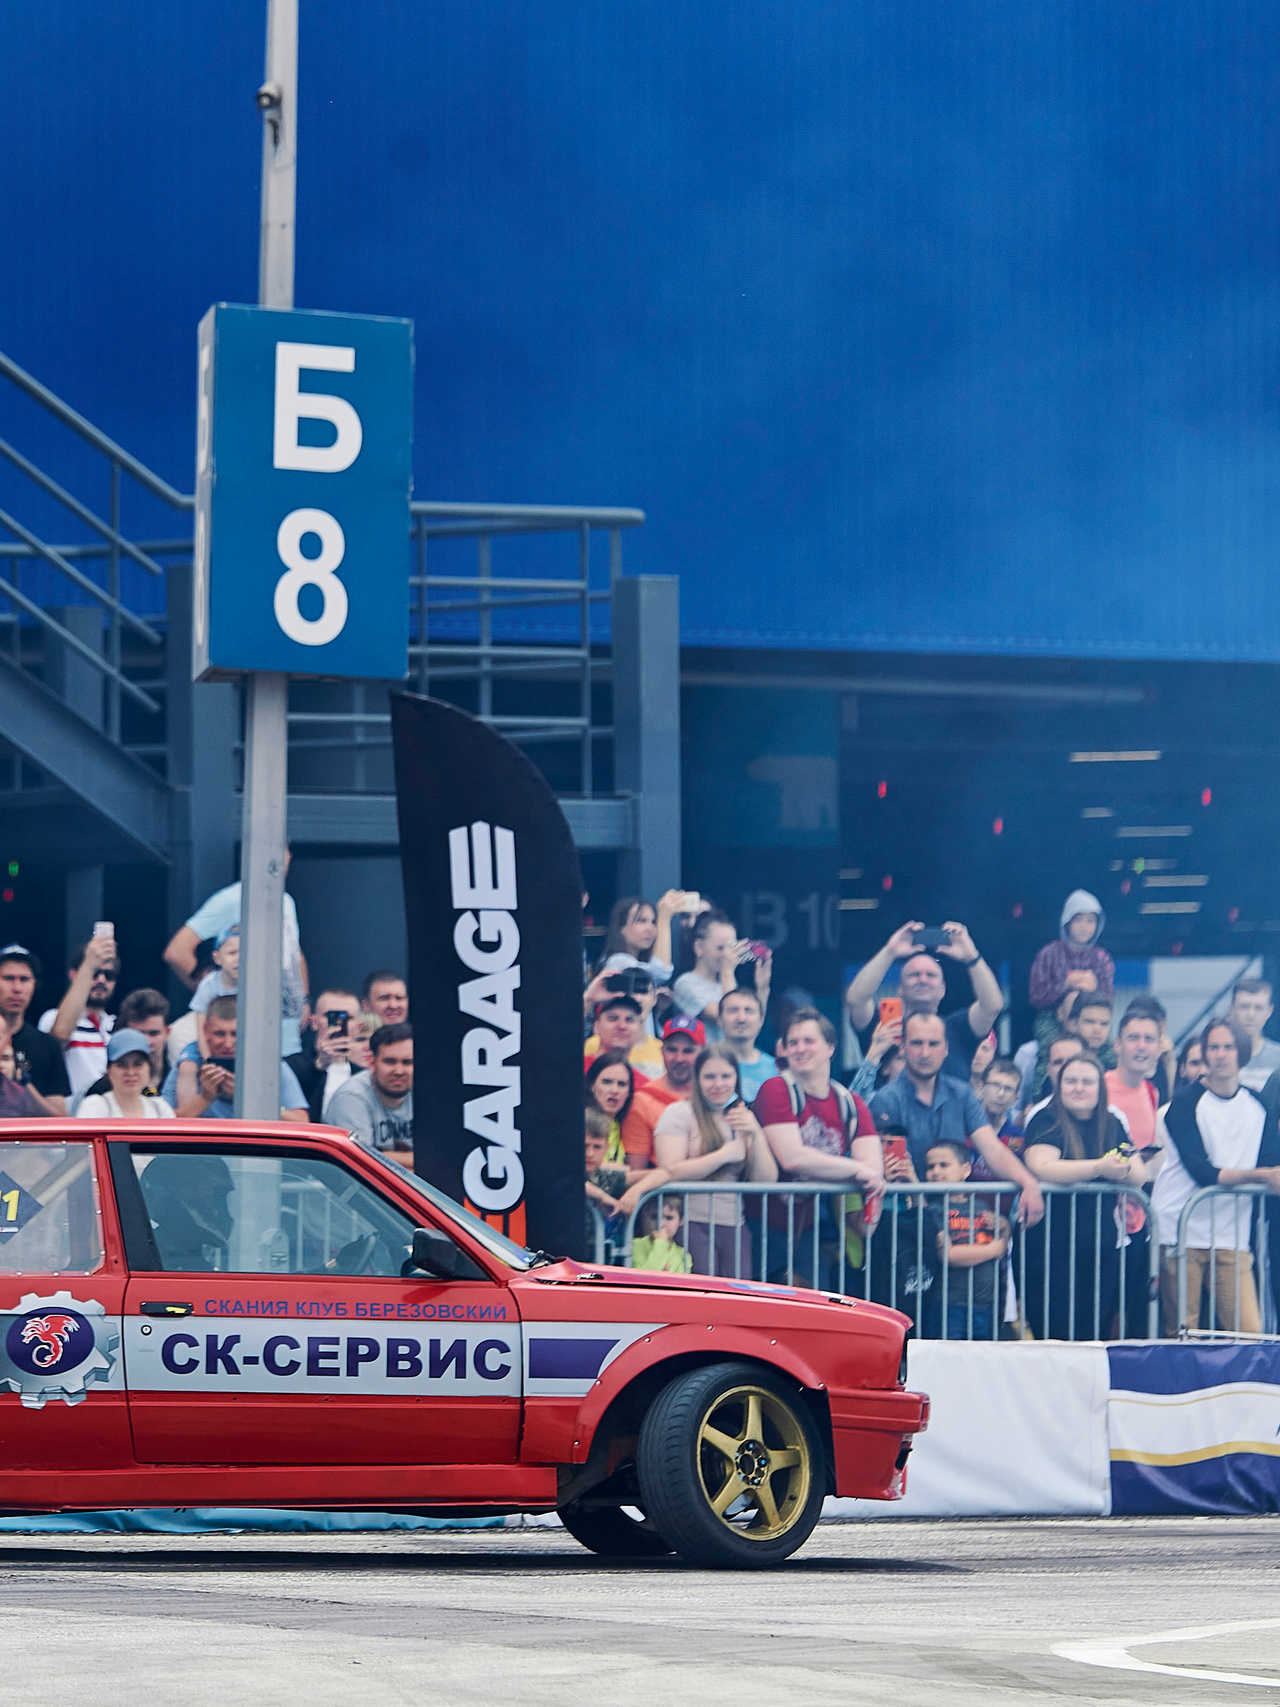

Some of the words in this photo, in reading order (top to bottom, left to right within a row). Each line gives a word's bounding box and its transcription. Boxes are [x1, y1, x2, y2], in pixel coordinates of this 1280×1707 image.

[273, 341, 363, 473] Б
[273, 508, 349, 646] 8
[449, 820, 526, 1210] GARAGE
[161, 1333, 512, 1381] СК-СЕРВИС
[204, 1299, 289, 1316] СКАНИЯ
[295, 1301, 349, 1317] КЛУБ
[355, 1301, 507, 1321] БЕРЕЗОВСКИЙ
